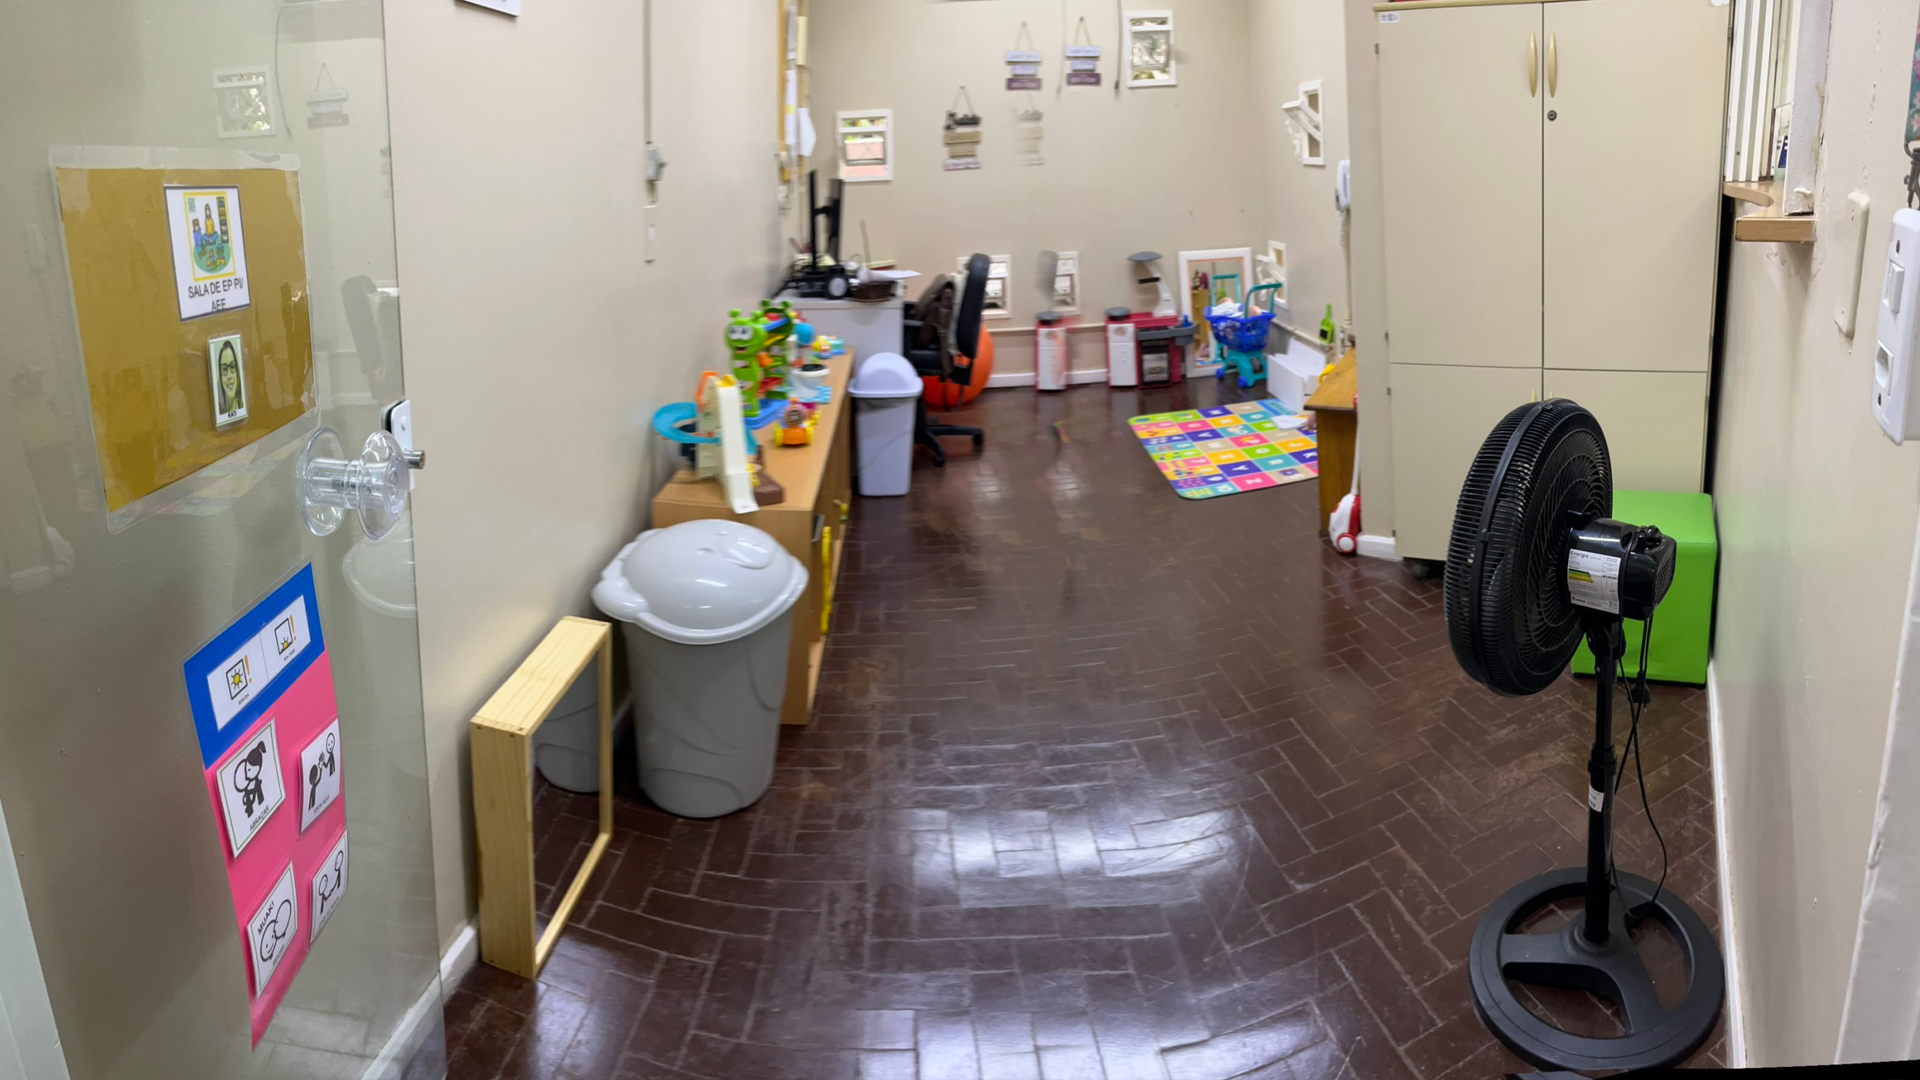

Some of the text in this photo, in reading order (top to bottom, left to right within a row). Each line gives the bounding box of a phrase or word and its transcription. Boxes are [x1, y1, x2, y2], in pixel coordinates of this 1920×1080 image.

[188, 284, 209, 298] SALA
[210, 281, 221, 294] DE
[222, 279, 232, 292] EP
[257, 900, 275, 935] MUAK!
